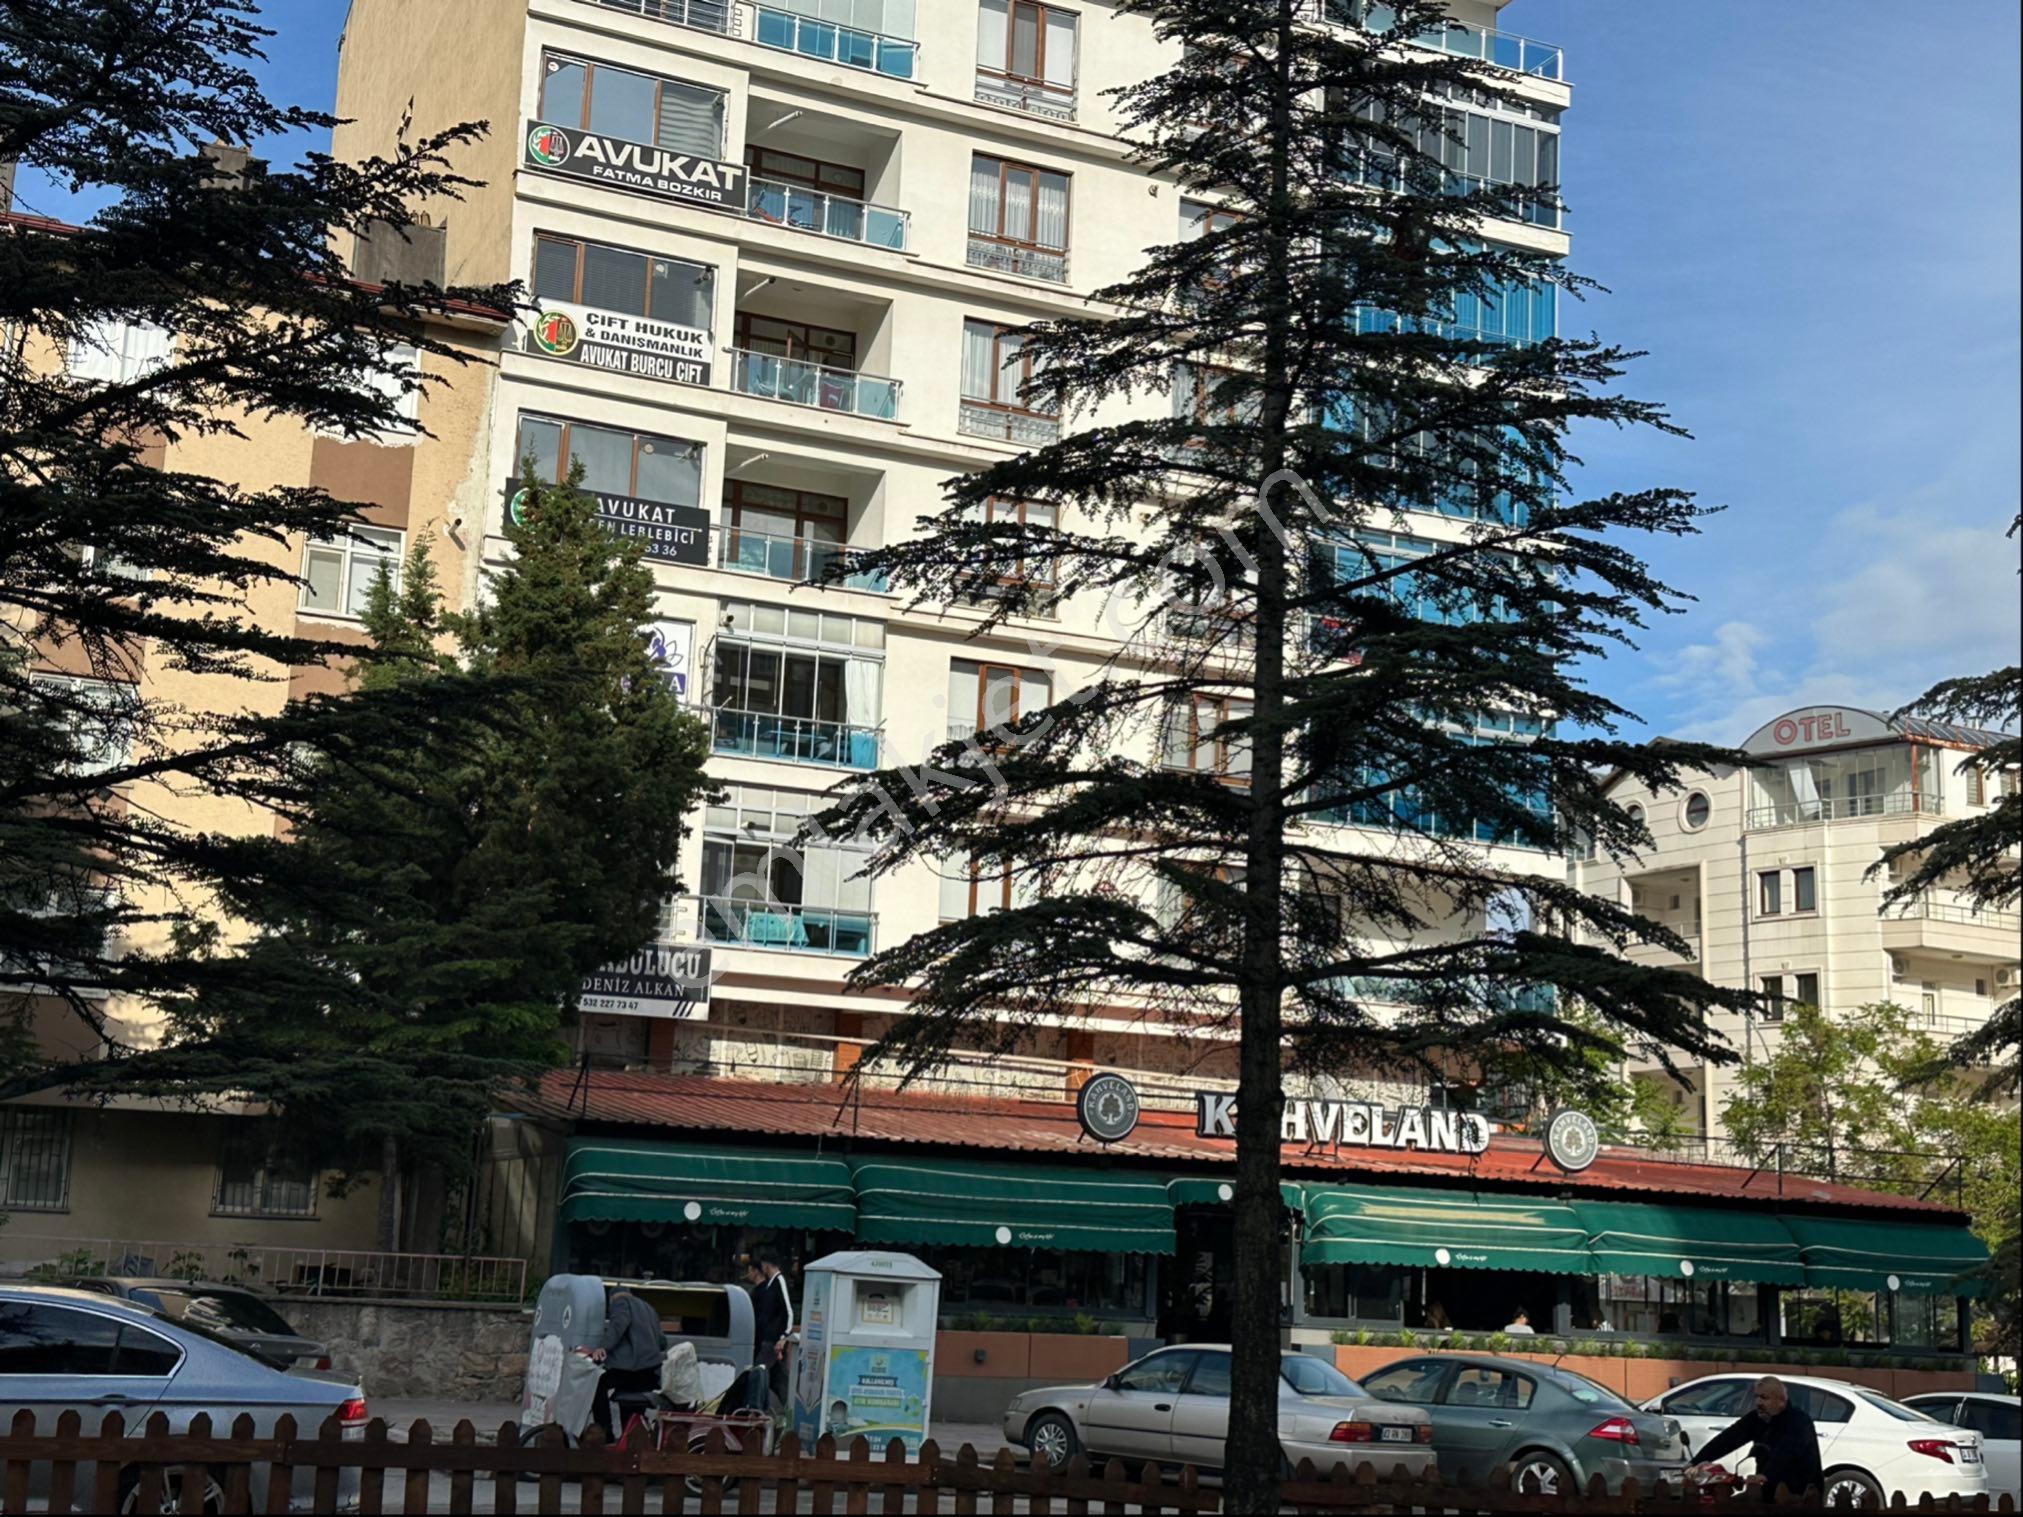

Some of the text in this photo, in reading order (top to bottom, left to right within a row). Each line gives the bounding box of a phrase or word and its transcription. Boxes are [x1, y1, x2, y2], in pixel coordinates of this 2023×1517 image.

[573, 135, 742, 191] AVUKAT
[593, 165, 722, 201] FATMA BOZKIR
[585, 327, 596, 338] &
[635, 321, 703, 345] HUKUK
[580, 343, 628, 370] AVUKAT
[631, 354, 673, 378] BURCU
[662, 546, 677, 557] 36
[1773, 712, 1851, 745] OTEL
[582, 977, 685, 997] DENİZ ALKAN
[1088, 1081, 1135, 1111] KAHVELAND
[1201, 1093, 1490, 1153] KHVELAND
